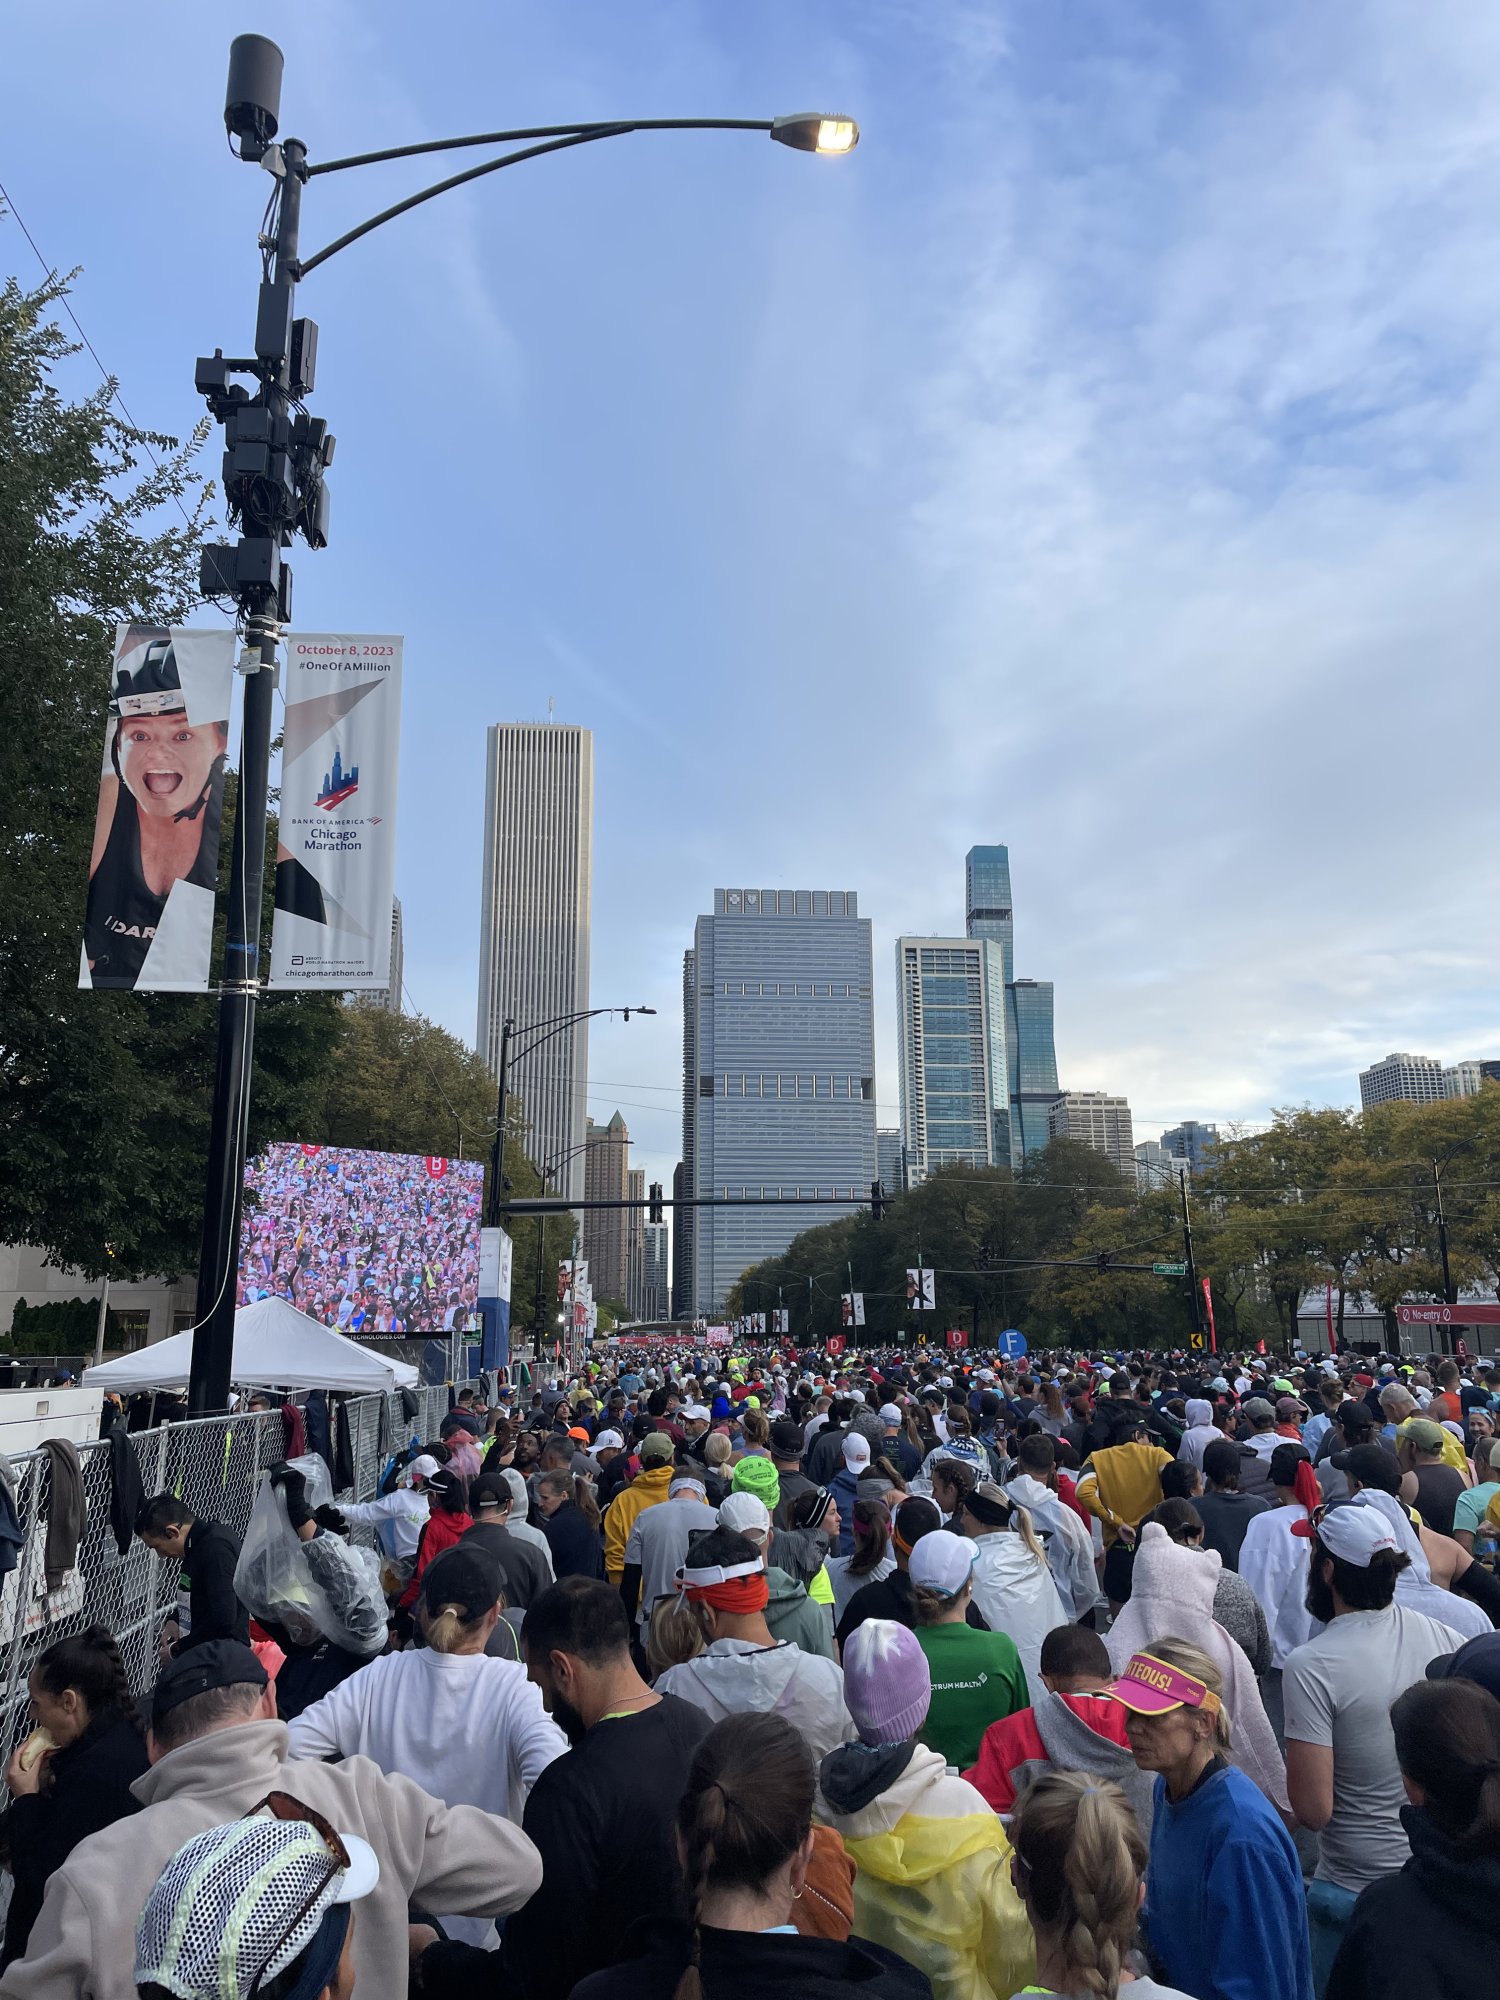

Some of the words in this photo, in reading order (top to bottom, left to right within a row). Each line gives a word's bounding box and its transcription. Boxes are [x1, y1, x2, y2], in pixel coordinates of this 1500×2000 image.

[297, 645, 346, 655] October
[349, 645, 360, 656] 8,
[363, 646, 394, 656] 2023
[310, 828, 357, 841] Chicago
[304, 840, 362, 851] Marathon
[285, 969, 374, 978] chicagomarathon.com
[431, 1156, 442, 1171] B
[1412, 1309, 1441, 1322] No-entry
[830, 1338, 839, 1350] D
[952, 1332, 962, 1344] D
[1005, 1332, 1018, 1351] F
[1459, 1341, 1465, 1353] E
[954, 1681, 982, 1689] HEALTH
